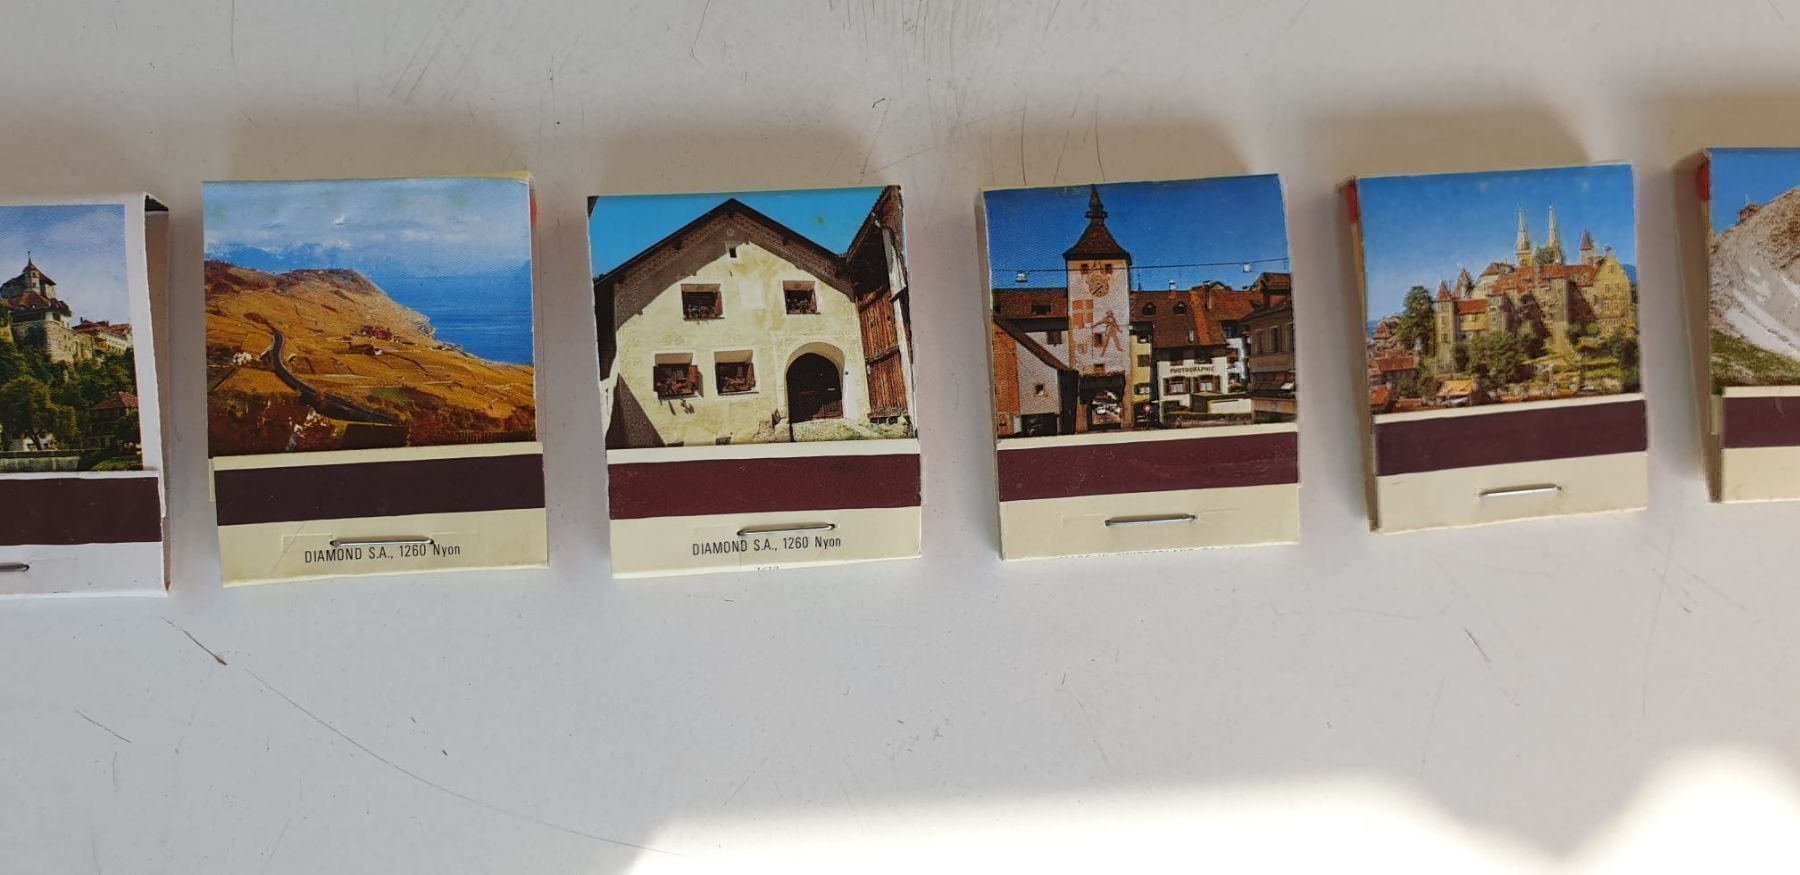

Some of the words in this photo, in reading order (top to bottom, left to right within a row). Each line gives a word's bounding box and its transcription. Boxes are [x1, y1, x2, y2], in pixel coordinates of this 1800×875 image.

[304, 547, 362, 563] DIAMOND
[368, 546, 393, 559] S.A.,
[399, 544, 427, 558] 1260
[433, 543, 461, 558] Nyon
[692, 540, 748, 556] DIAMOND
[753, 538, 778, 552] S.A.,
[783, 536, 809, 549] 1260
[815, 535, 841, 549] Nyon
